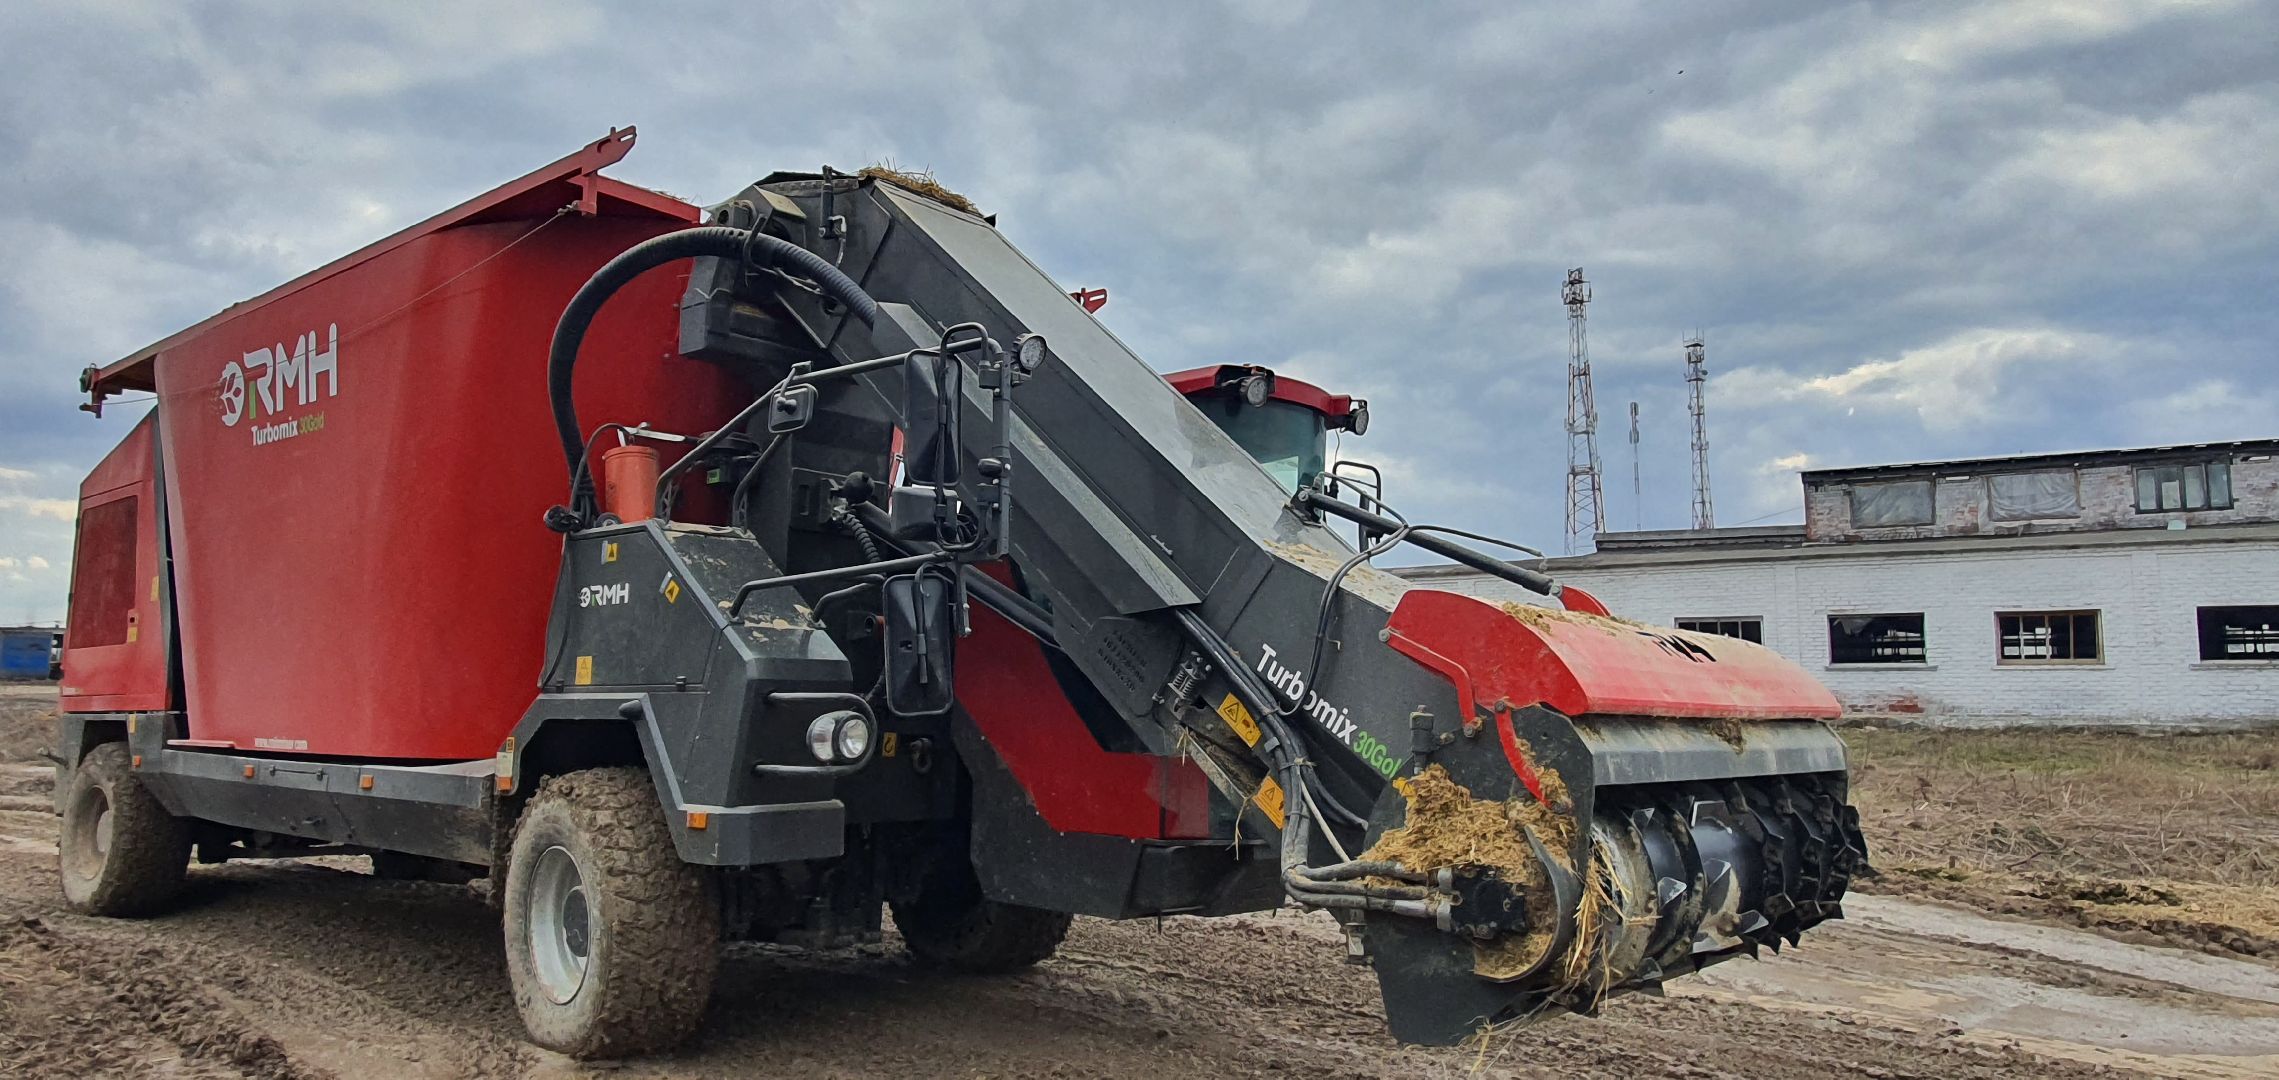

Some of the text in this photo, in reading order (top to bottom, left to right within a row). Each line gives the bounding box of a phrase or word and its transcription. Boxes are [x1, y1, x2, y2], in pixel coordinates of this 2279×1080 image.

[243, 322, 338, 420] RMH
[251, 416, 298, 446] Turbomix
[590, 582, 630, 606] RMH
[1256, 643, 1402, 780] Turbomix 30Gol
